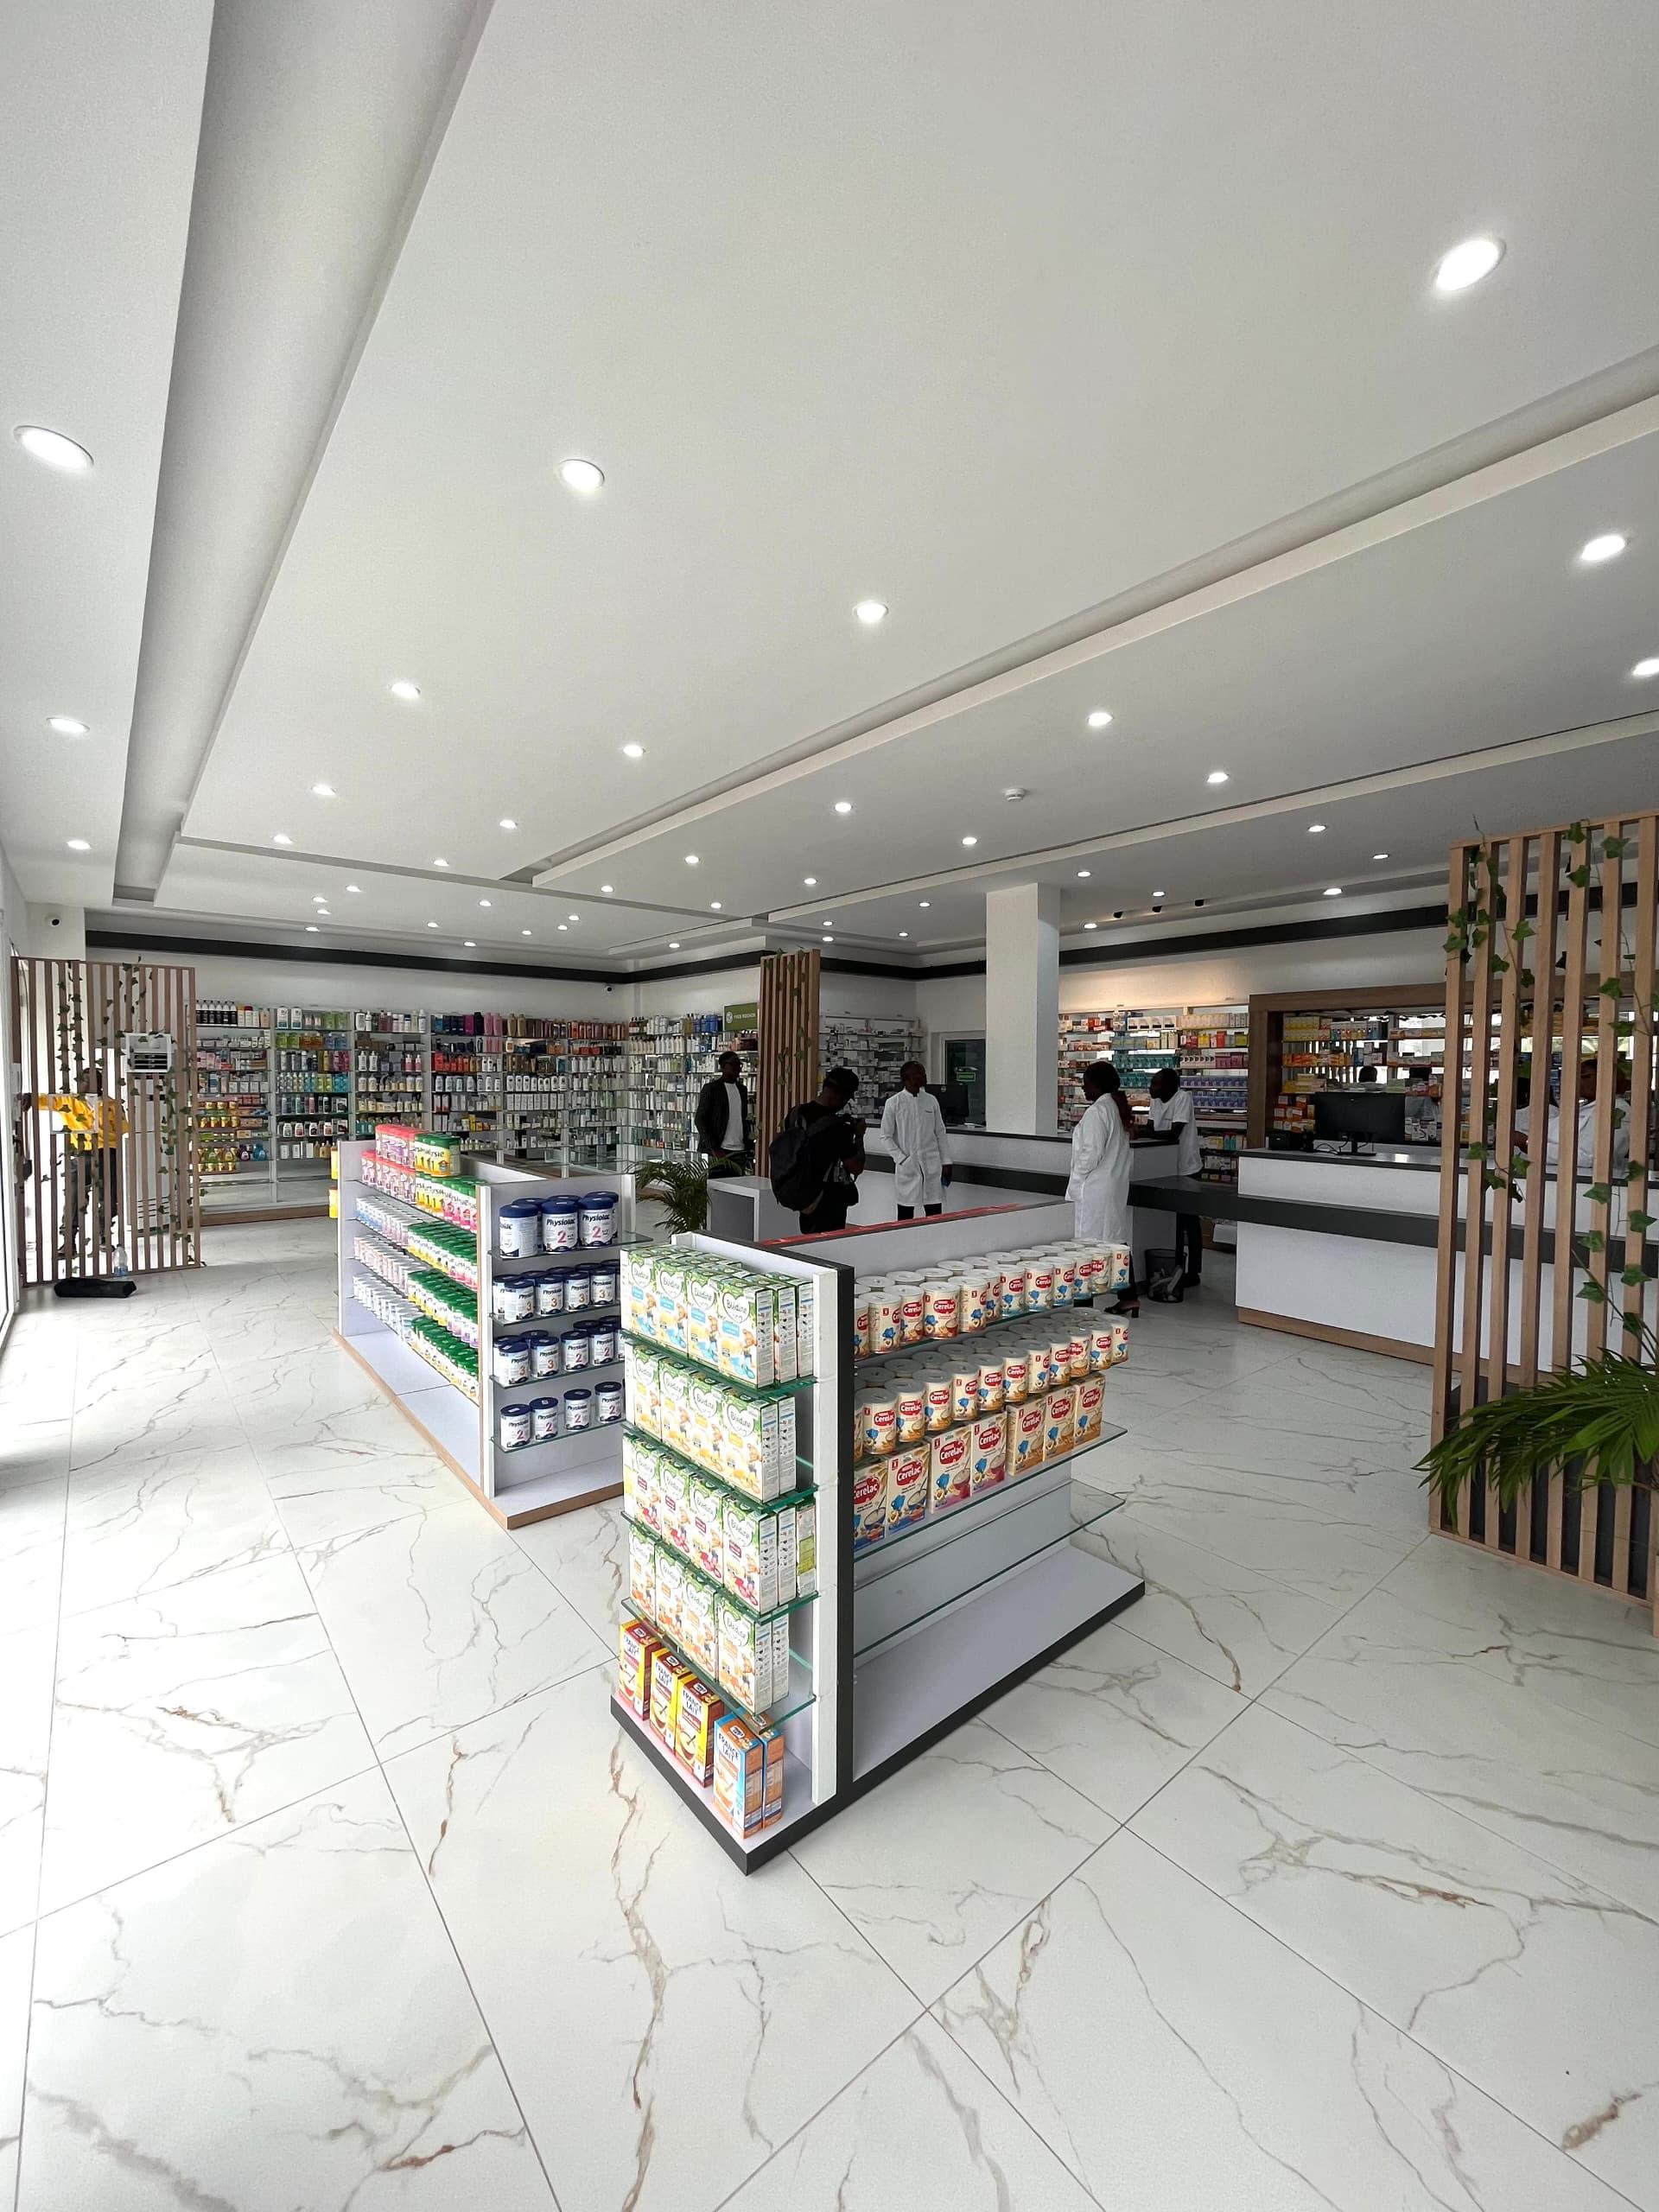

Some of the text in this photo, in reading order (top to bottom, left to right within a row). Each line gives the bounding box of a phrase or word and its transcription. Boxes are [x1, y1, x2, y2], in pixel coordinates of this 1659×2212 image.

[546, 1217, 575, 1227] Physiolac
[582, 1213, 609, 1223] Physiolac
[557, 1230, 567, 1243] 2
[593, 1225, 601, 1238] 2
[900, 1404, 921, 1413] Cerelac
[874, 1414, 894, 1423] Cerelac
[979, 1432, 999, 1446] Cerelac
[940, 1446, 963, 1460] Cerelac
[898, 1466, 921, 1481] Cerelac
